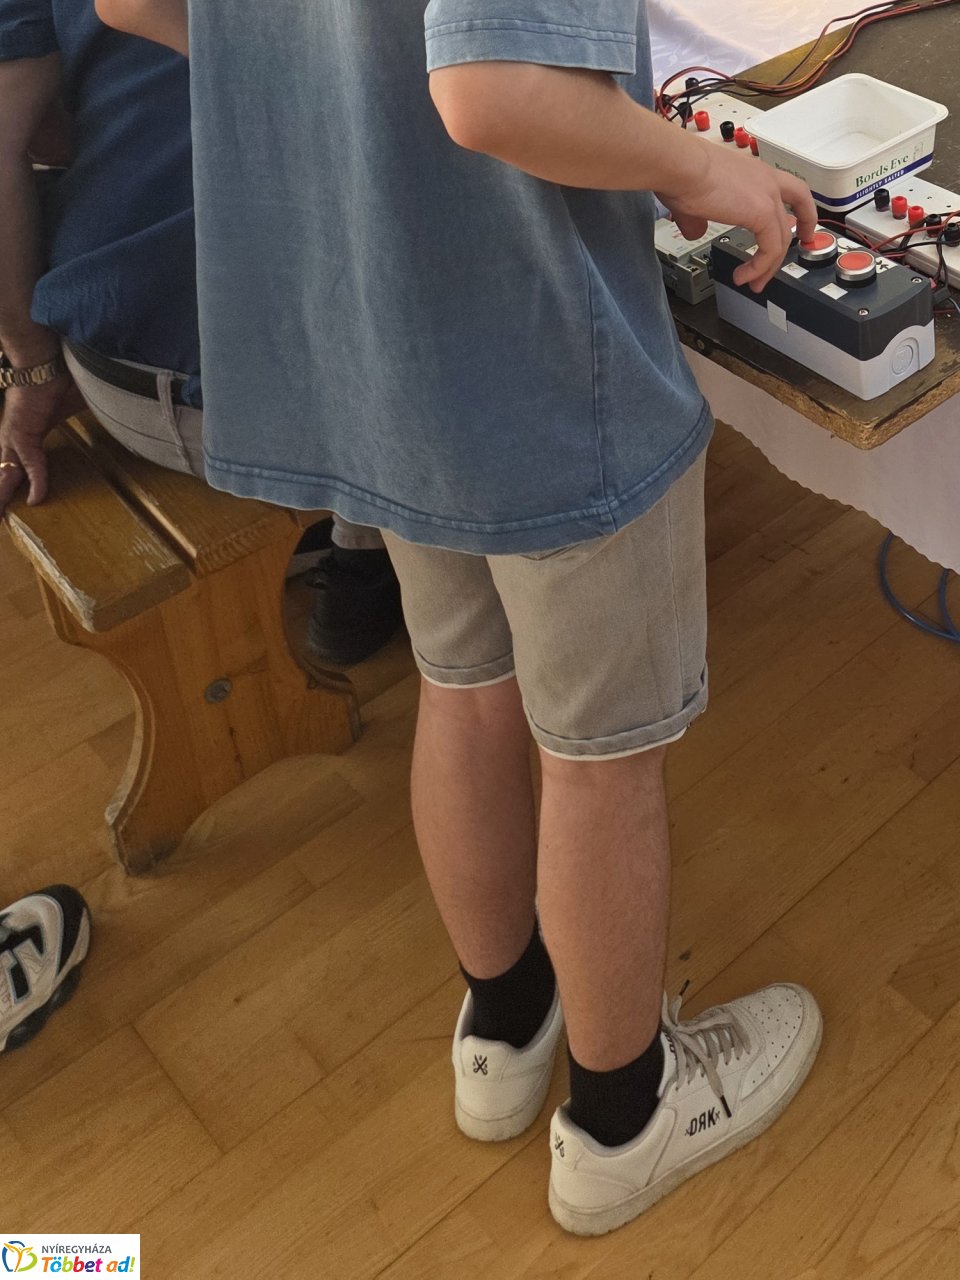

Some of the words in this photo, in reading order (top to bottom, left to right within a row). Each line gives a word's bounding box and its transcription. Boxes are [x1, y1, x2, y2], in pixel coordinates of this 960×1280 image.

[855, 164, 889, 188] Bords
[890, 155, 909, 171] Eve
[856, 180, 883, 199] SLIGHTLY
[884, 169, 906, 184] SALTED
